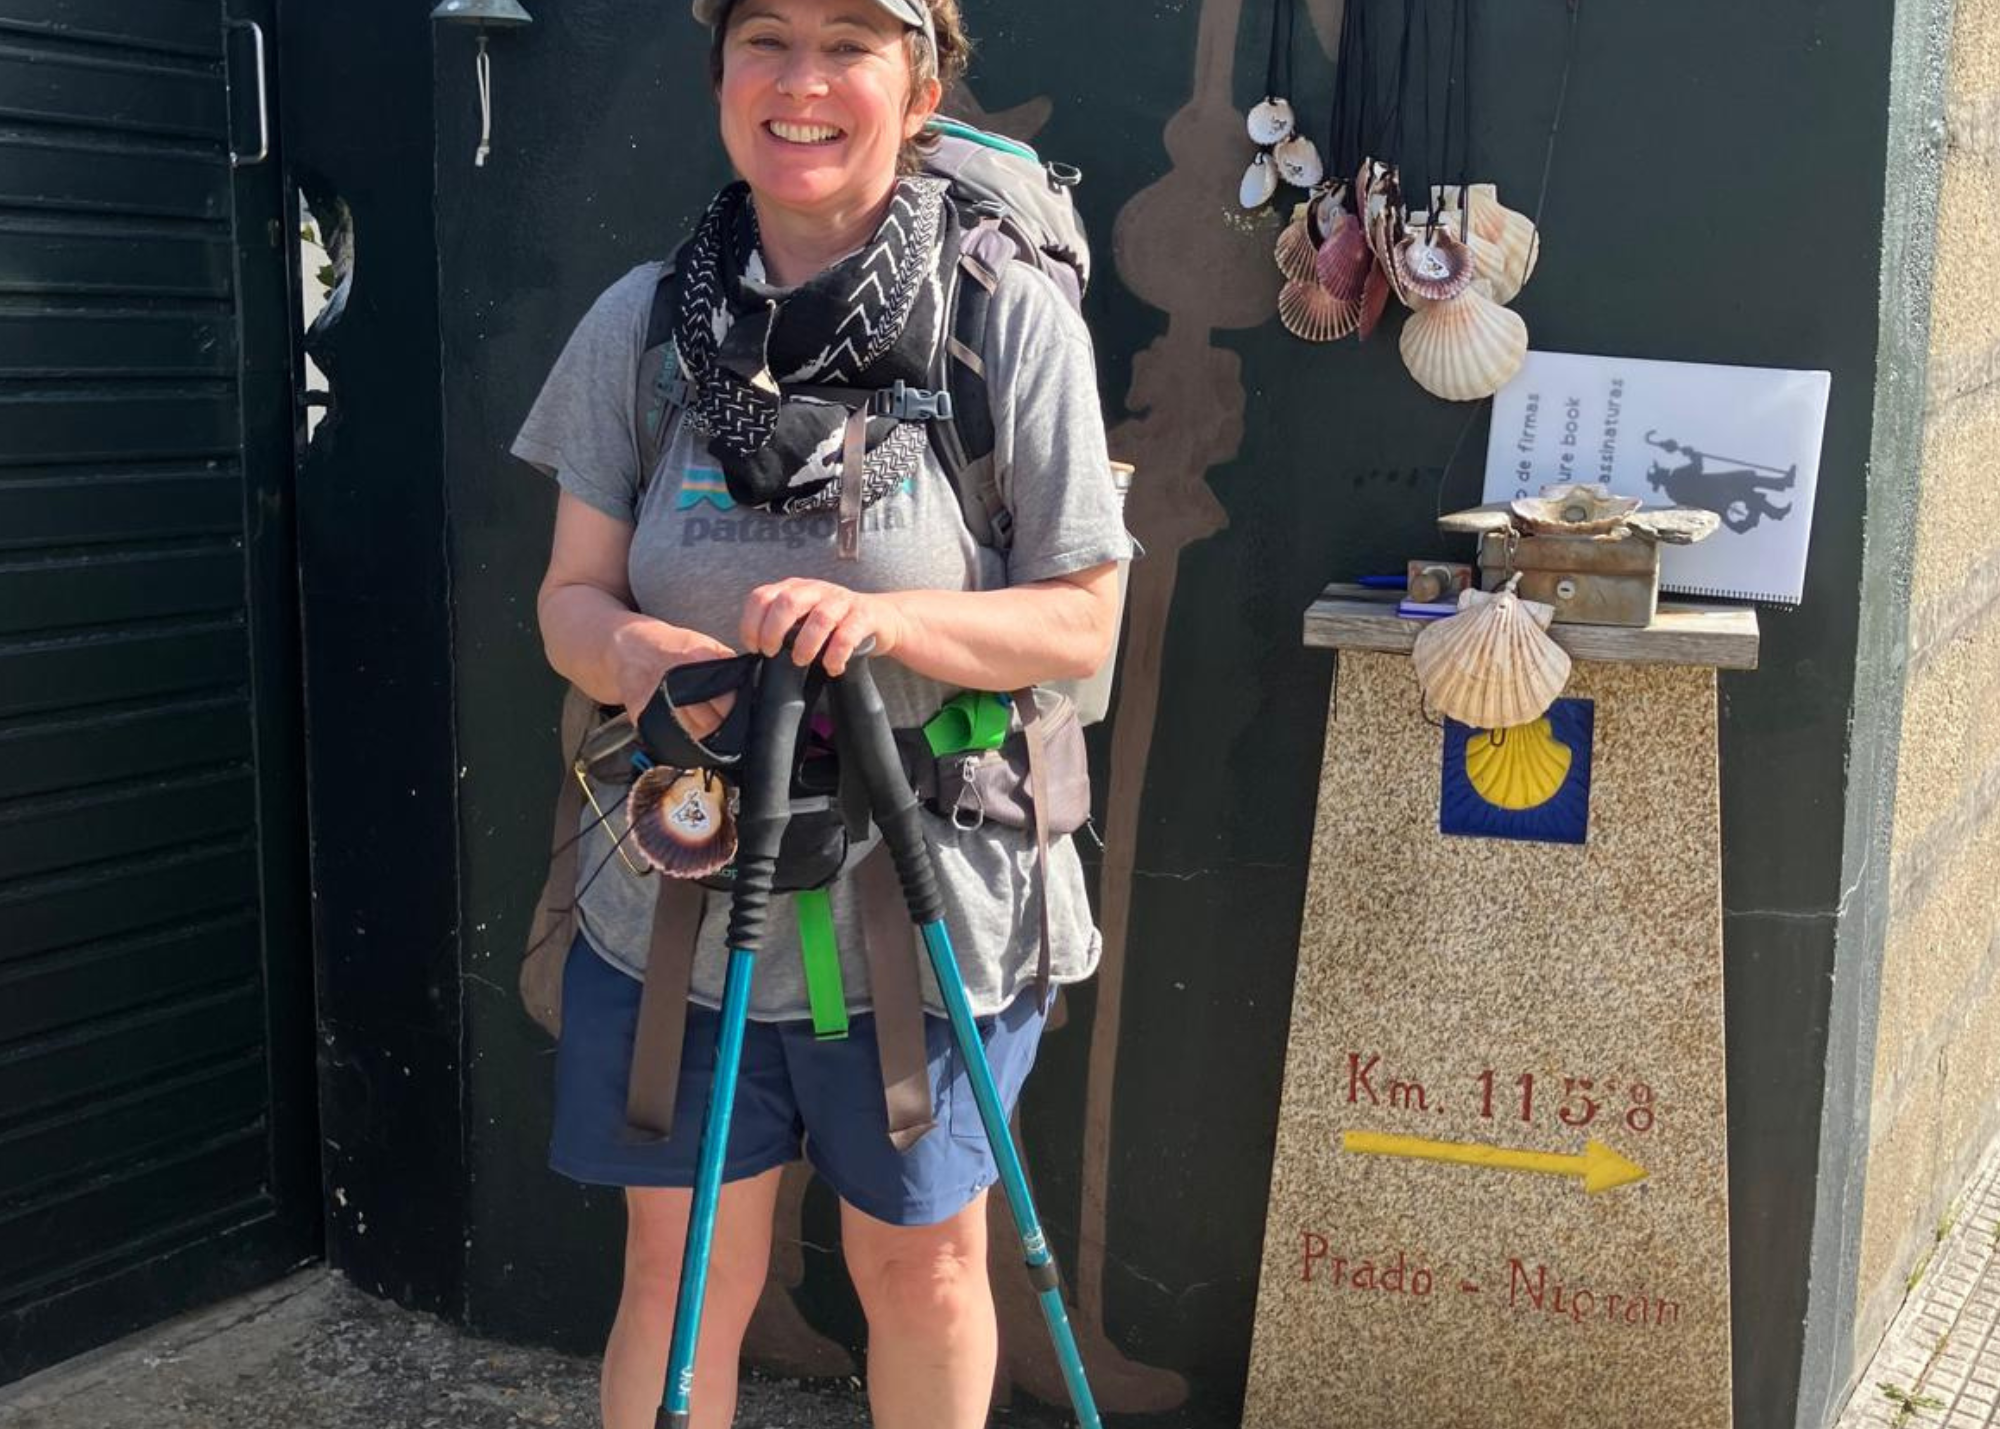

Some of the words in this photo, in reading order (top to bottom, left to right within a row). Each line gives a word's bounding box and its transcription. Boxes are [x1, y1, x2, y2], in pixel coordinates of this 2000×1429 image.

[1517, 392, 1540, 453] firmas
[1560, 396, 1581, 447] book
[1598, 378, 1625, 484] assinaturas
[1515, 459, 1532, 482] de
[1346, 1052, 1445, 1115] Km.
[1301, 1230, 1433, 1296] Prado
